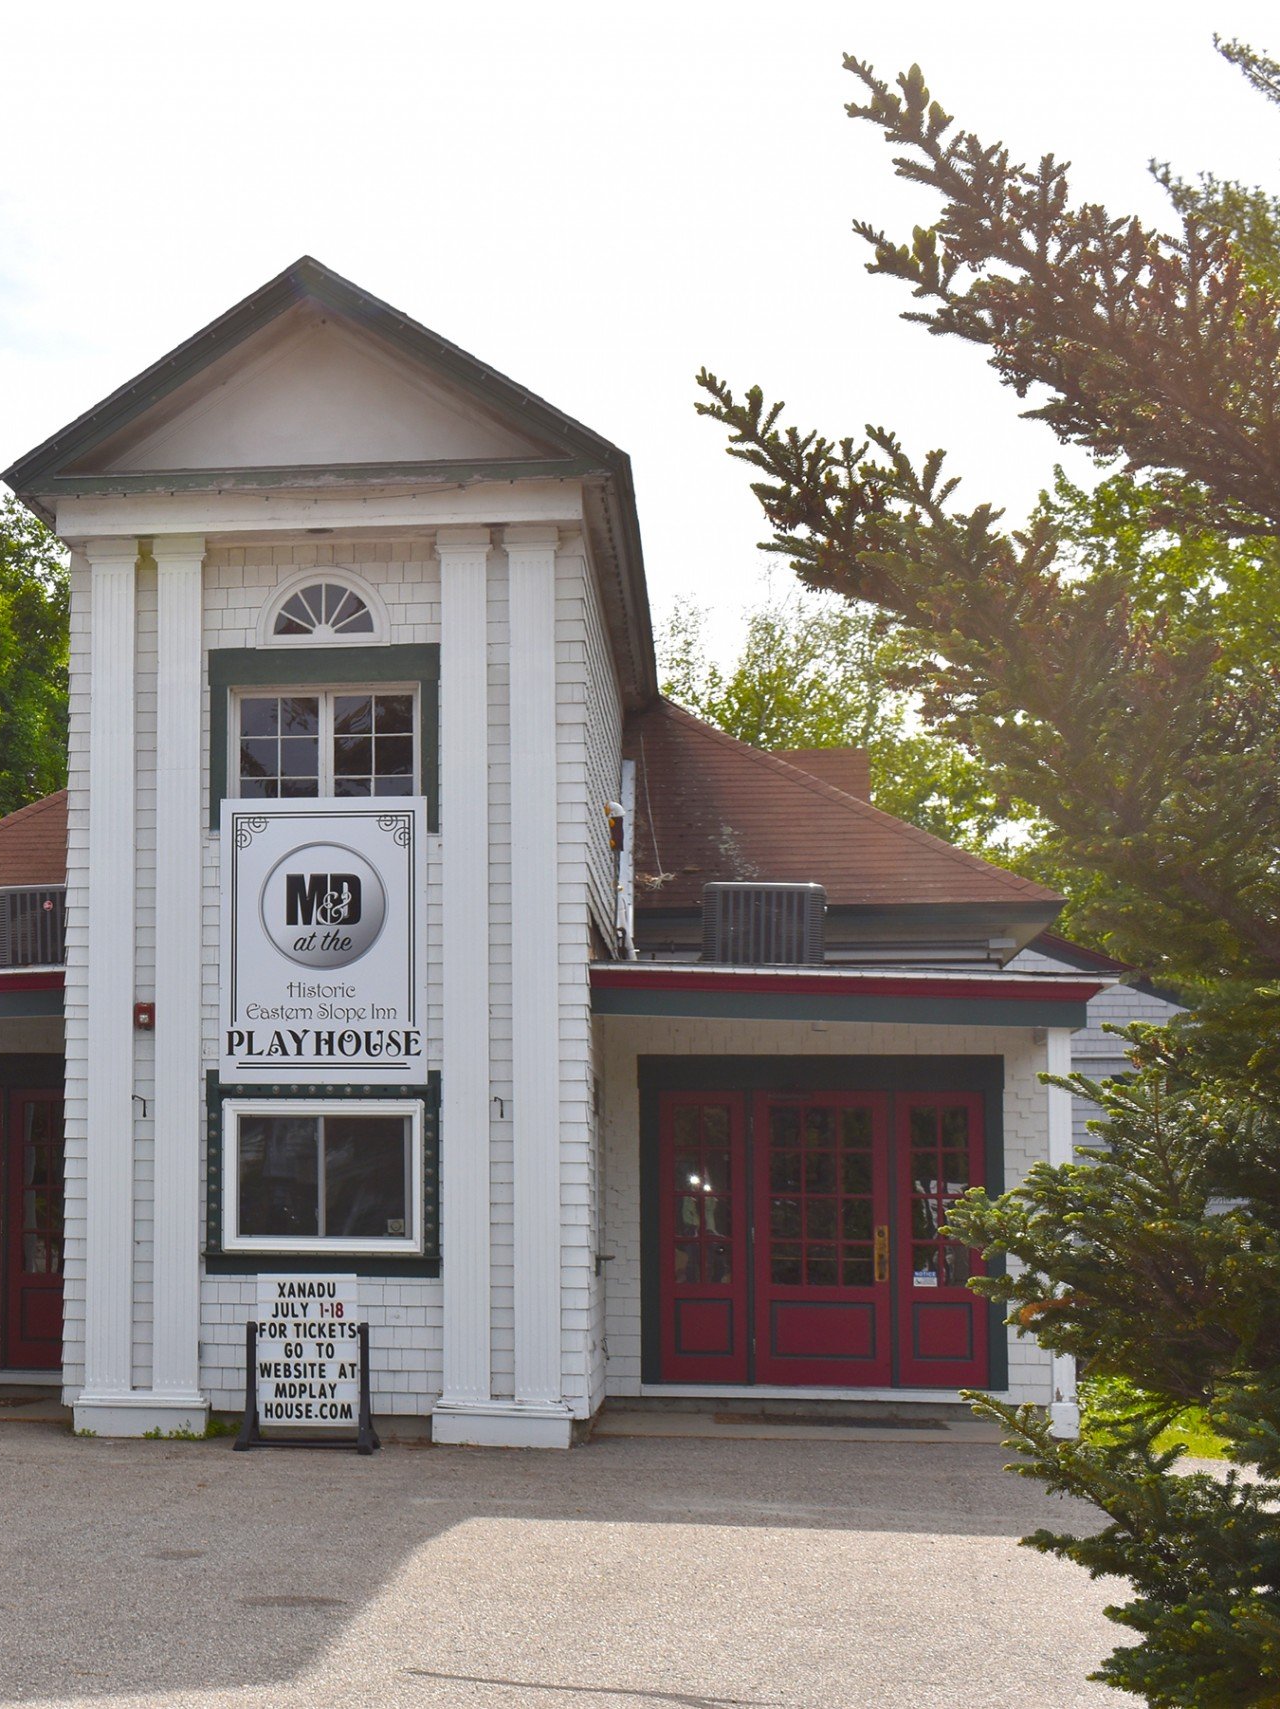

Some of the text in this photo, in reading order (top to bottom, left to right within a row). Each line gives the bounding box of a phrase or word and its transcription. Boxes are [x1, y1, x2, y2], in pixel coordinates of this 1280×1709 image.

[286, 874, 361, 925] M&D
[293, 930, 352, 951] at the
[287, 981, 356, 998] Historic
[246, 1003, 397, 1024] Eastern Slope Inn
[226, 1029, 422, 1057] PLAYHOUSE
[277, 1282, 336, 1298] XANADU
[272, 1302, 344, 1318] JULY 1-18
[259, 1322, 357, 1338] FOR TICKETS
[284, 1342, 334, 1358] GO TO
[260, 1363, 357, 1378] WEBSITE AT
[274, 1383, 337, 1398] MDPLAY
[264, 1403, 353, 1419] HOUSE.COM
